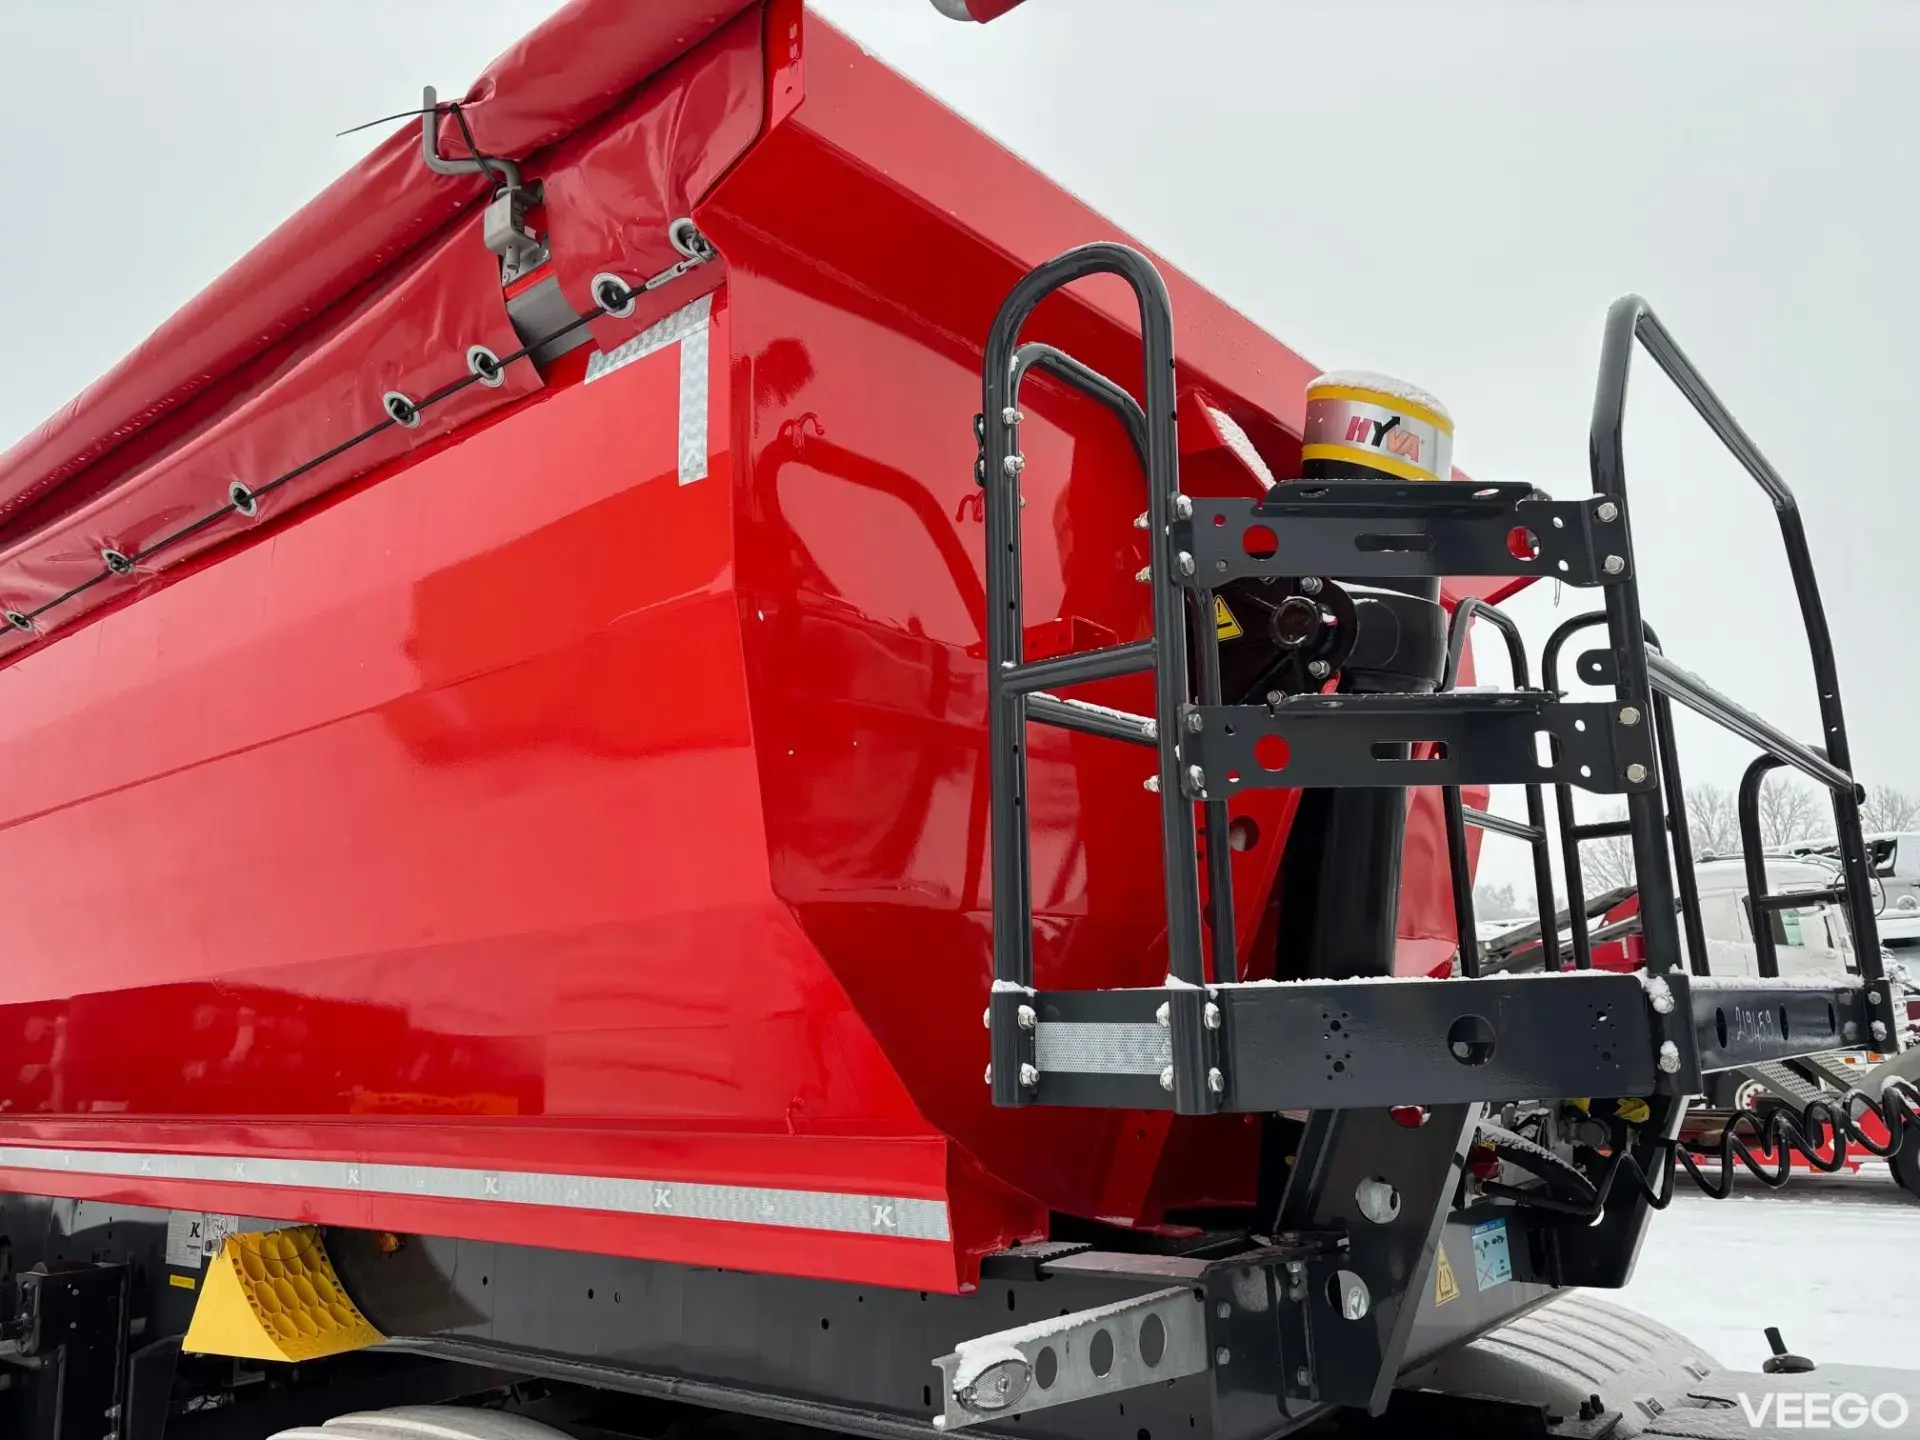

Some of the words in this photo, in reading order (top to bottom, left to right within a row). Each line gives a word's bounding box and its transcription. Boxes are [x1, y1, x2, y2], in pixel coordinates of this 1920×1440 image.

[1345, 415, 1419, 462] HYVA
[347, 1169, 360, 1185] K
[483, 1177, 499, 1194] K
[653, 1188, 673, 1208] K
[872, 1204, 896, 1227] K
[189, 1222, 201, 1238] K
